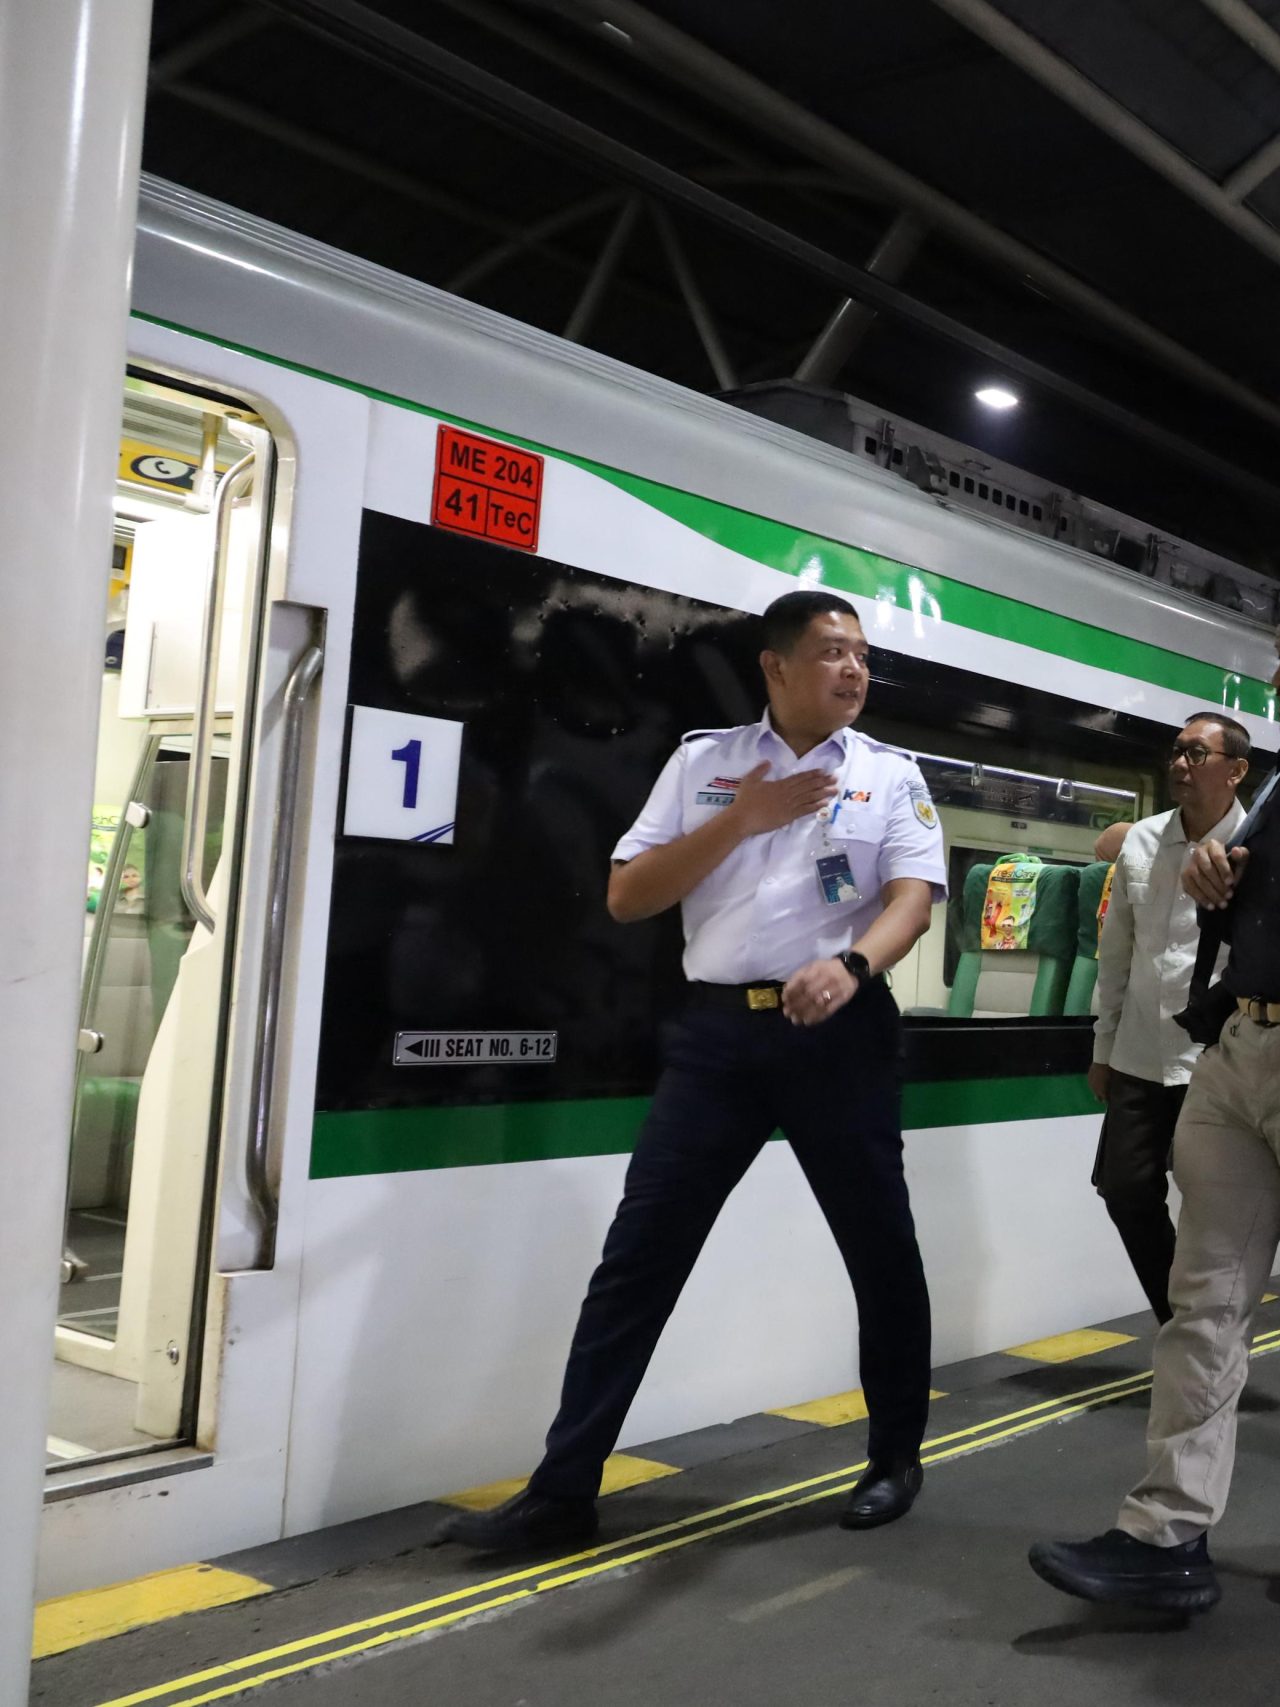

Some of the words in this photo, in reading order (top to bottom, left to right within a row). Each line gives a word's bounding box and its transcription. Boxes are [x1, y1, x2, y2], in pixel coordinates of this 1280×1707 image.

[450, 441, 487, 475] ME
[494, 455, 533, 488] 204
[444, 488, 478, 522] 41
[490, 503, 532, 535] TeC
[391, 739, 422, 809] 1
[445, 1038, 483, 1057] SEAT
[489, 1038, 513, 1057] NO.
[519, 1038, 551, 1056] 6-12
